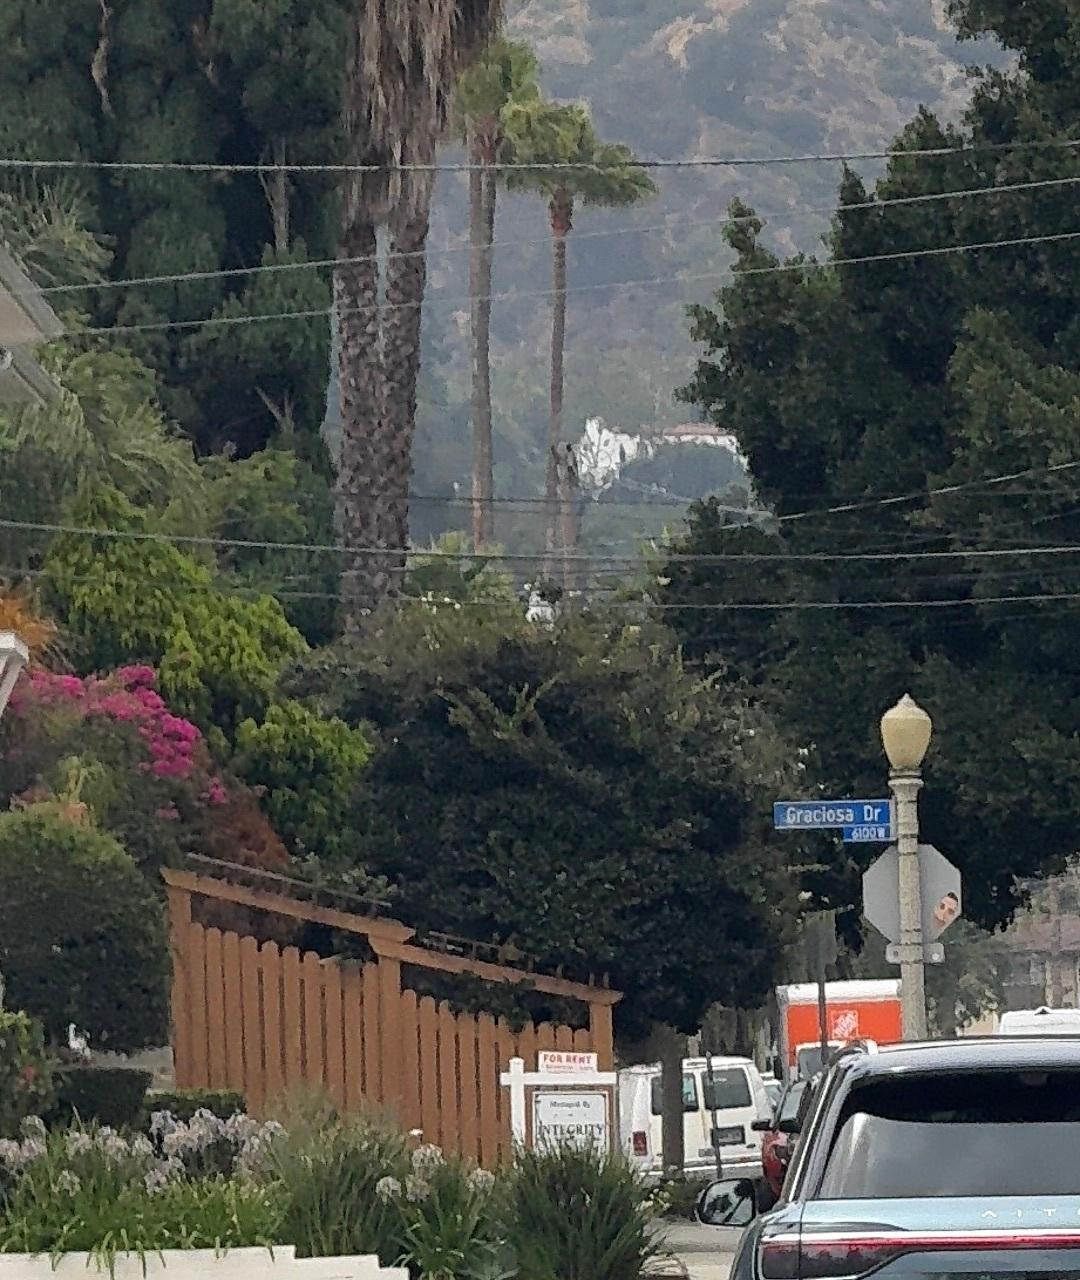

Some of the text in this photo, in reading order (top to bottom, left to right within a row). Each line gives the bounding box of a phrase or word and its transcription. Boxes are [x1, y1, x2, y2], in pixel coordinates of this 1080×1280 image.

[786, 805, 882, 824] Graciosa Dr
[544, 1053, 592, 1065] FOR RENT
[538, 1123, 604, 1136] INTEGRITY
